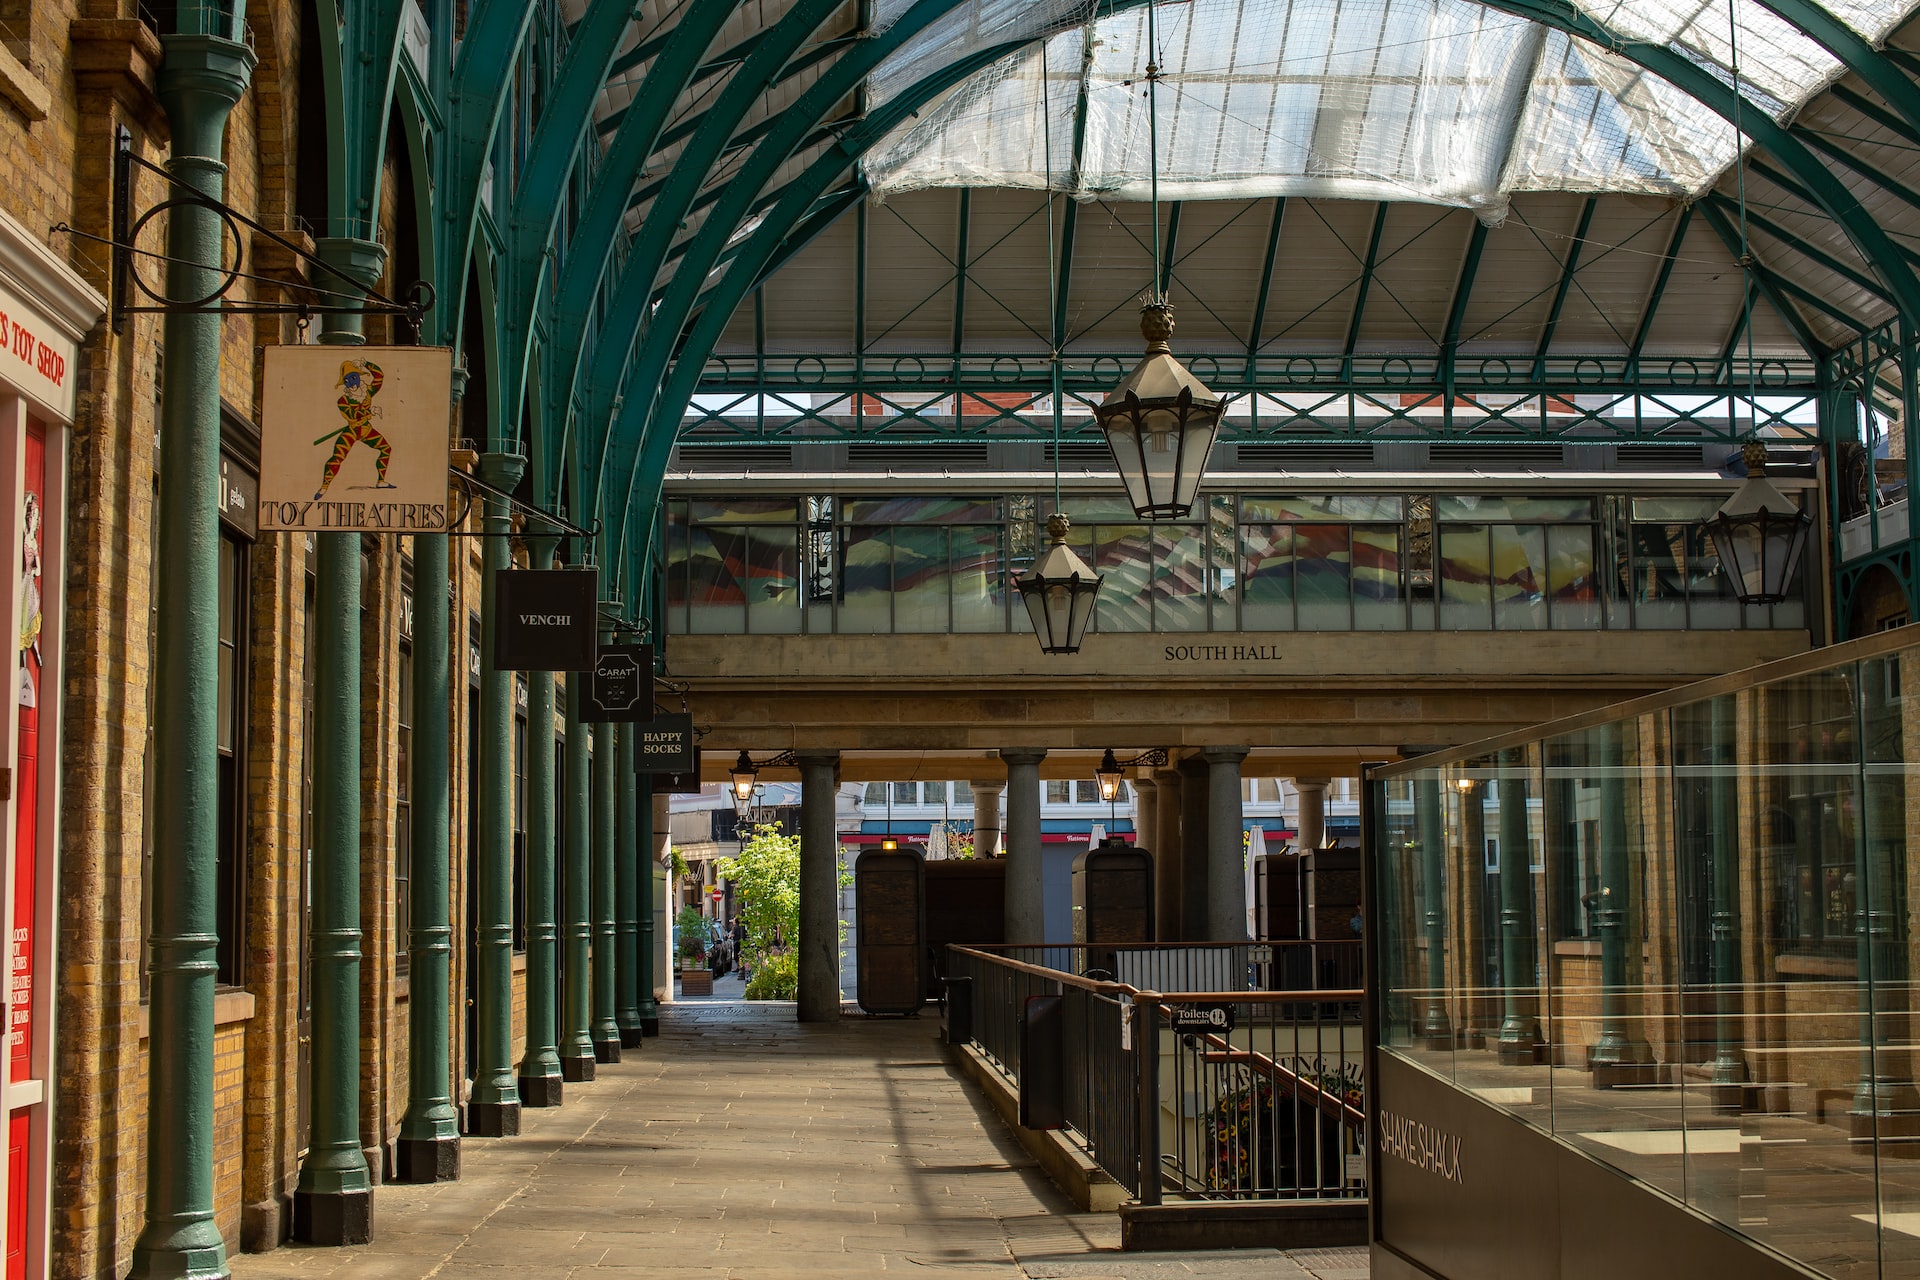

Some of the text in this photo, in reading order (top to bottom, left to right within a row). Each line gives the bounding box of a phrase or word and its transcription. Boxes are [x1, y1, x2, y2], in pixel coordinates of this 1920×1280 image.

[12, 321, 36, 367] TOY
[37, 341, 65, 388] SHOP
[262, 501, 445, 529] TOY THEATRES
[520, 614, 571, 626] VENCHI
[1165, 645, 1283, 661] SOUTH HALL
[643, 732, 682, 742] HAPPY
[643, 744, 682, 754] SOCKS
[1178, 1009, 1209, 1018] Toilets
[1380, 1109, 1463, 1185] SHAKE SHACK
